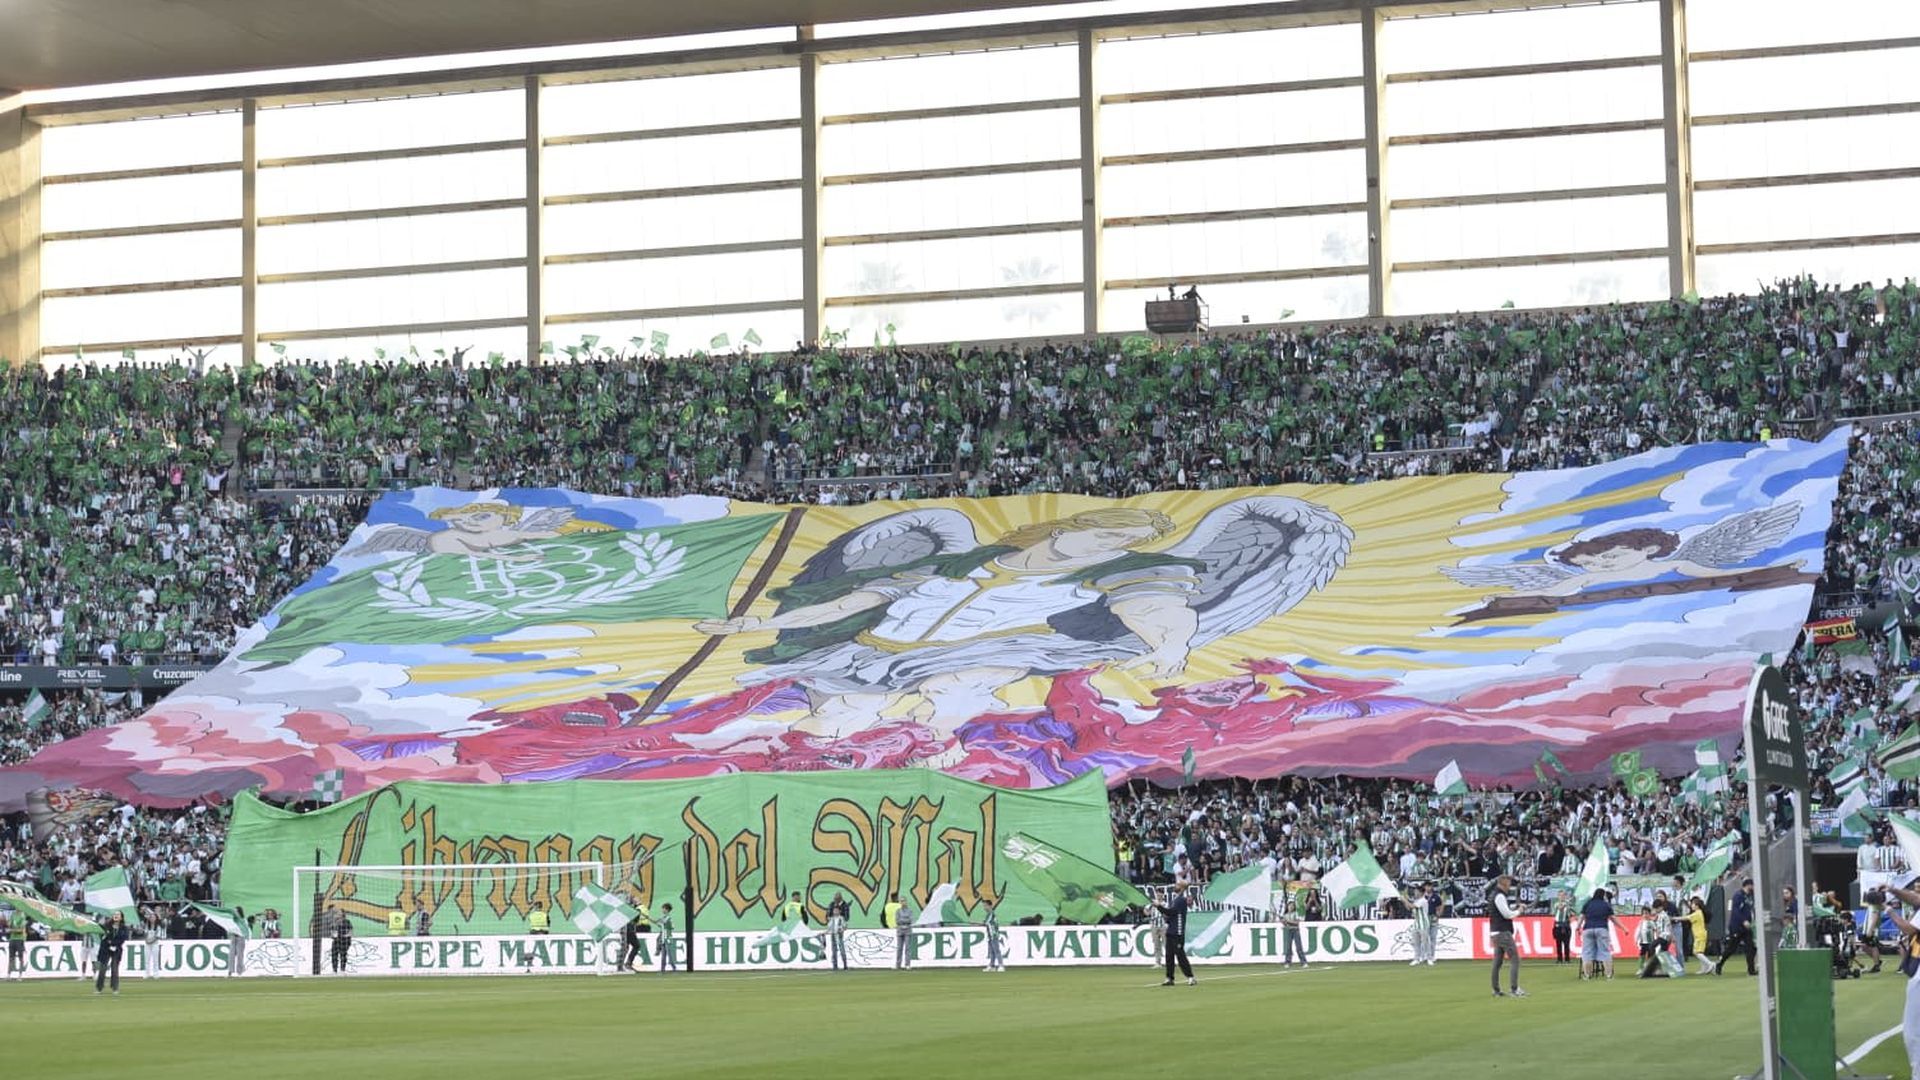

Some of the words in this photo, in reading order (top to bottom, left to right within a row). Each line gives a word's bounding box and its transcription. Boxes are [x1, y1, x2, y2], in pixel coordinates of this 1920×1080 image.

[1819, 608, 1863, 618] FOREVER
[57, 669, 106, 678] REVEL
[806, 793, 1007, 926] Mal
[390, 941, 485, 968] PEPE
[705, 936, 824, 964] HIJOS
[1250, 924, 1379, 956] HIJOS
